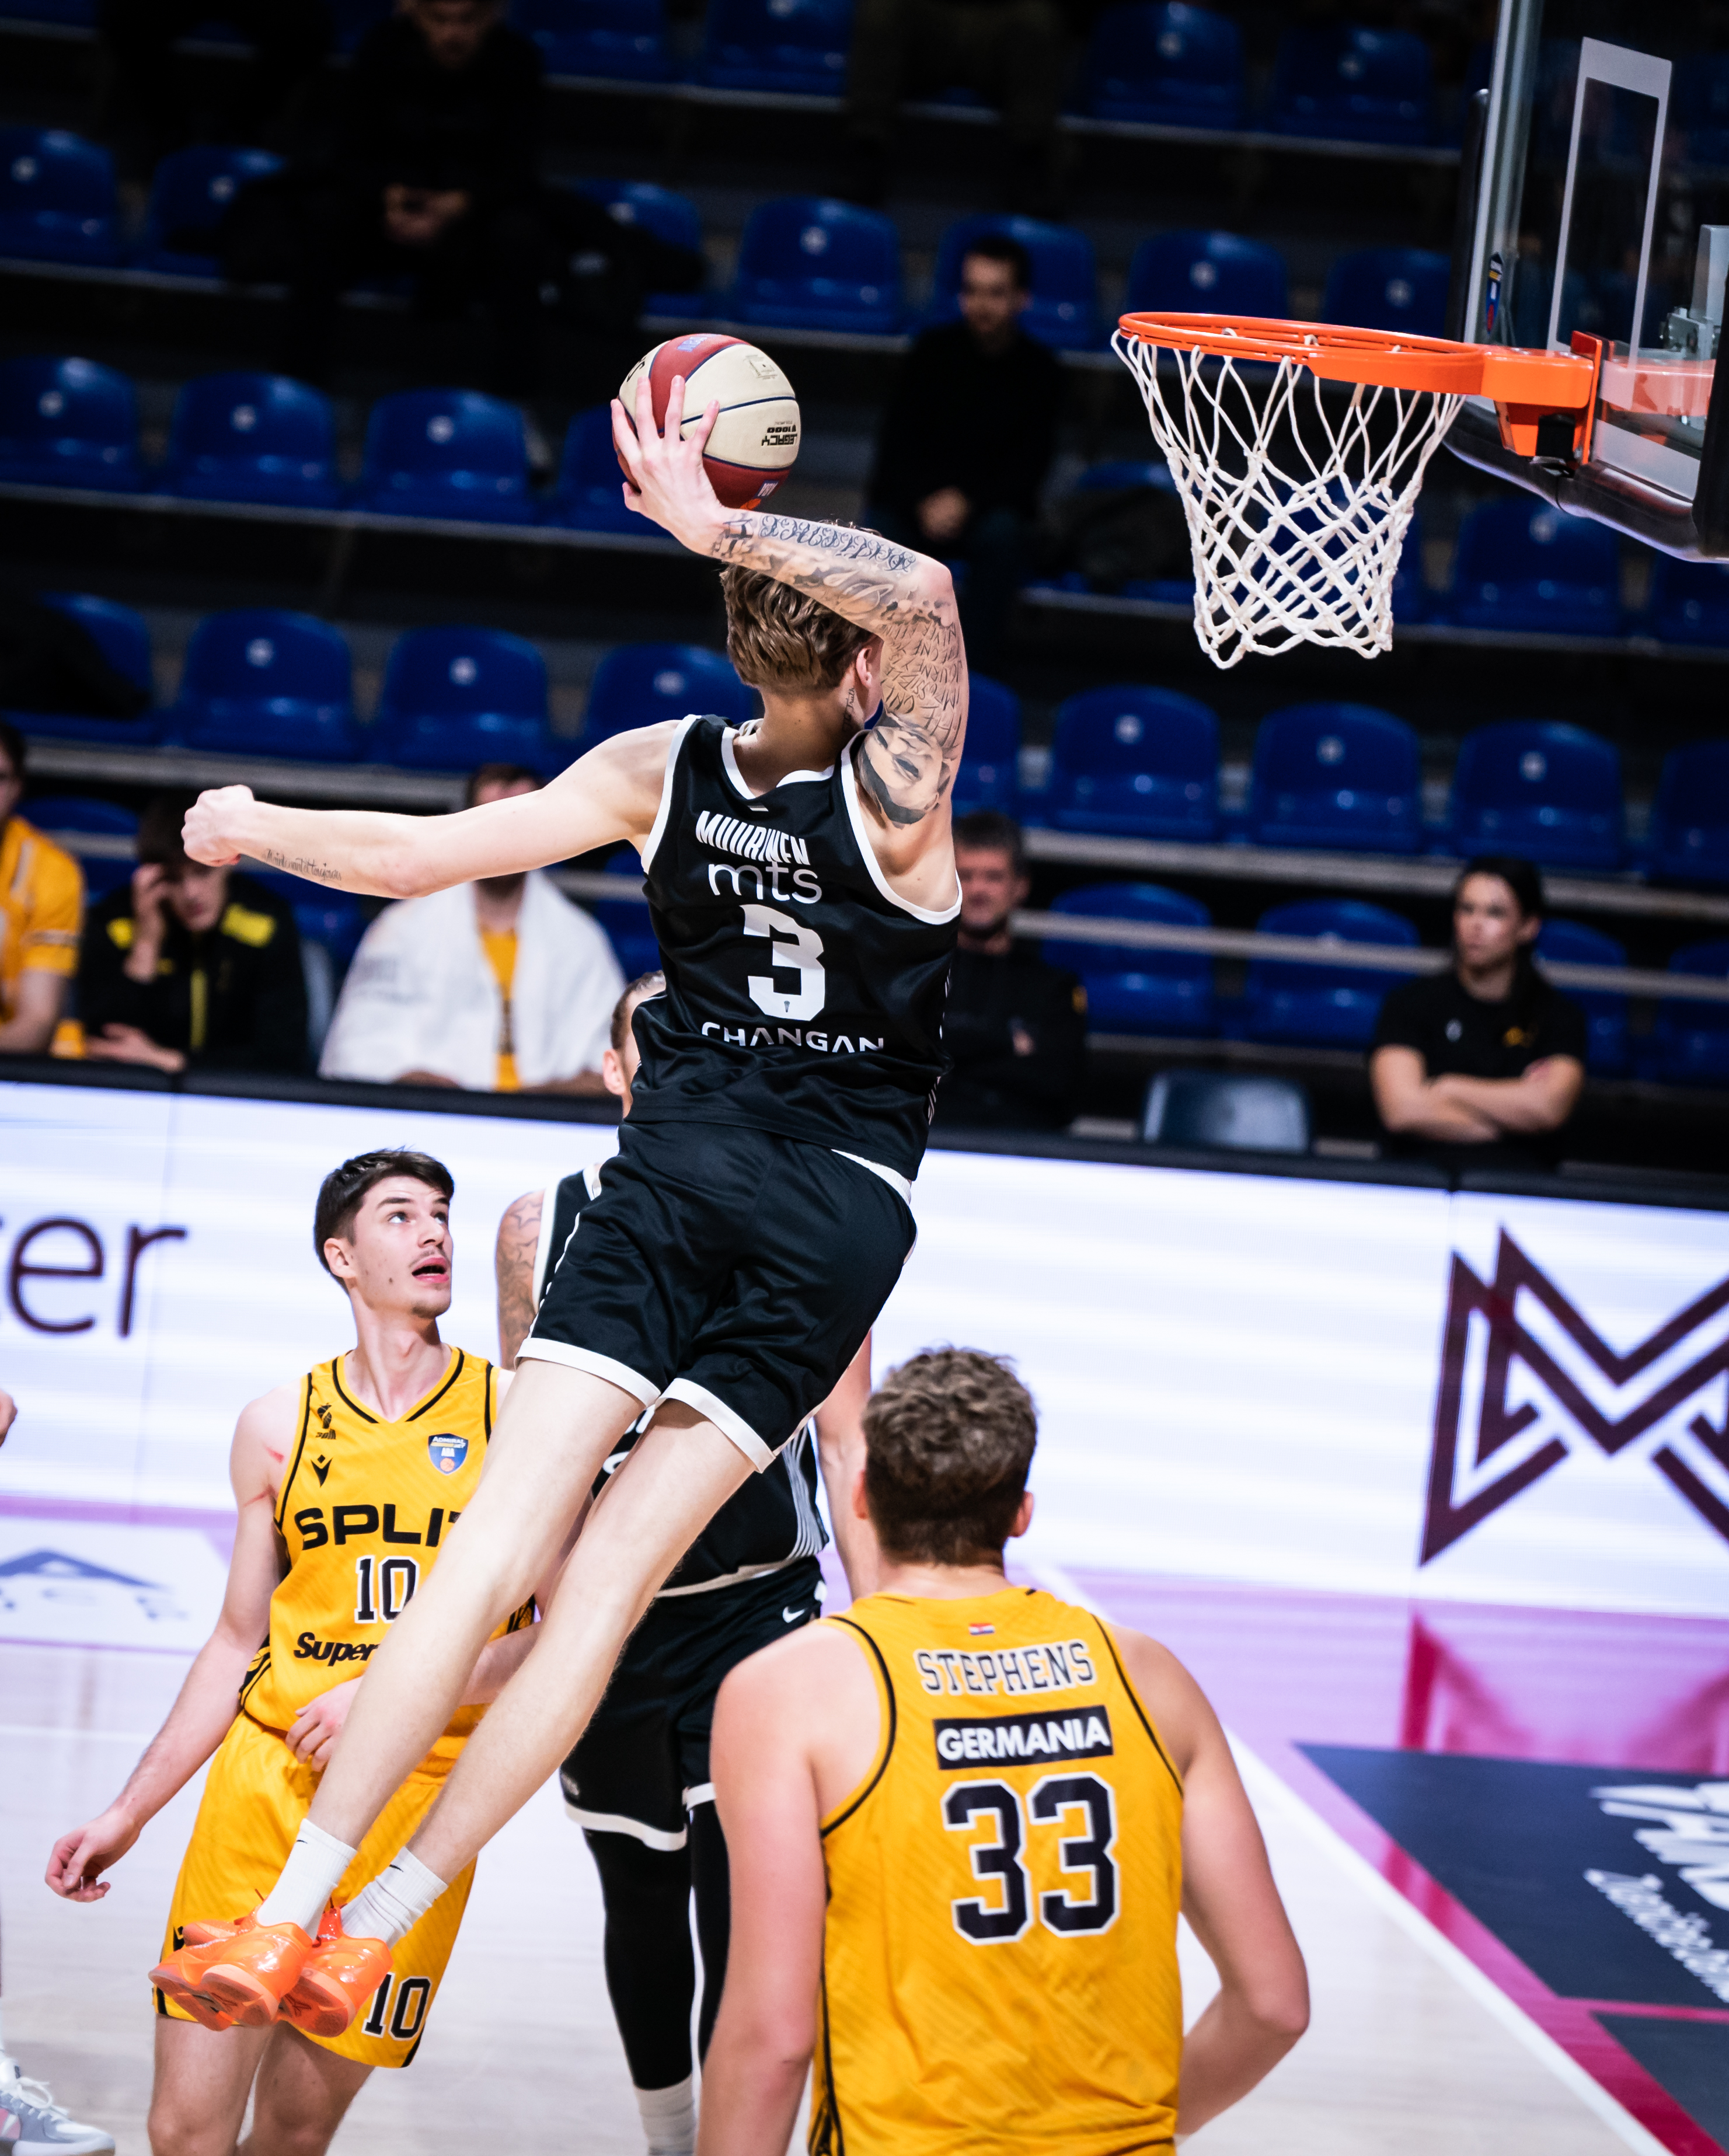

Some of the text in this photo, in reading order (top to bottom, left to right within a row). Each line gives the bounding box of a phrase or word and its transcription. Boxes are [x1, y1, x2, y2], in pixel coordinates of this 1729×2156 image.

[761, 434, 798, 446] LEGACY
[708, 861, 822, 905] mts
[738, 903, 826, 1022] 3
[701, 1021, 884, 1053] CHANGAN
[354, 1554, 420, 1624] 10
[914, 1638, 1097, 1697] STEPHENS
[937, 1715, 1111, 1763] GERMANIA
[940, 1771, 1121, 1946] 33
[361, 1971, 431, 2041] 10
